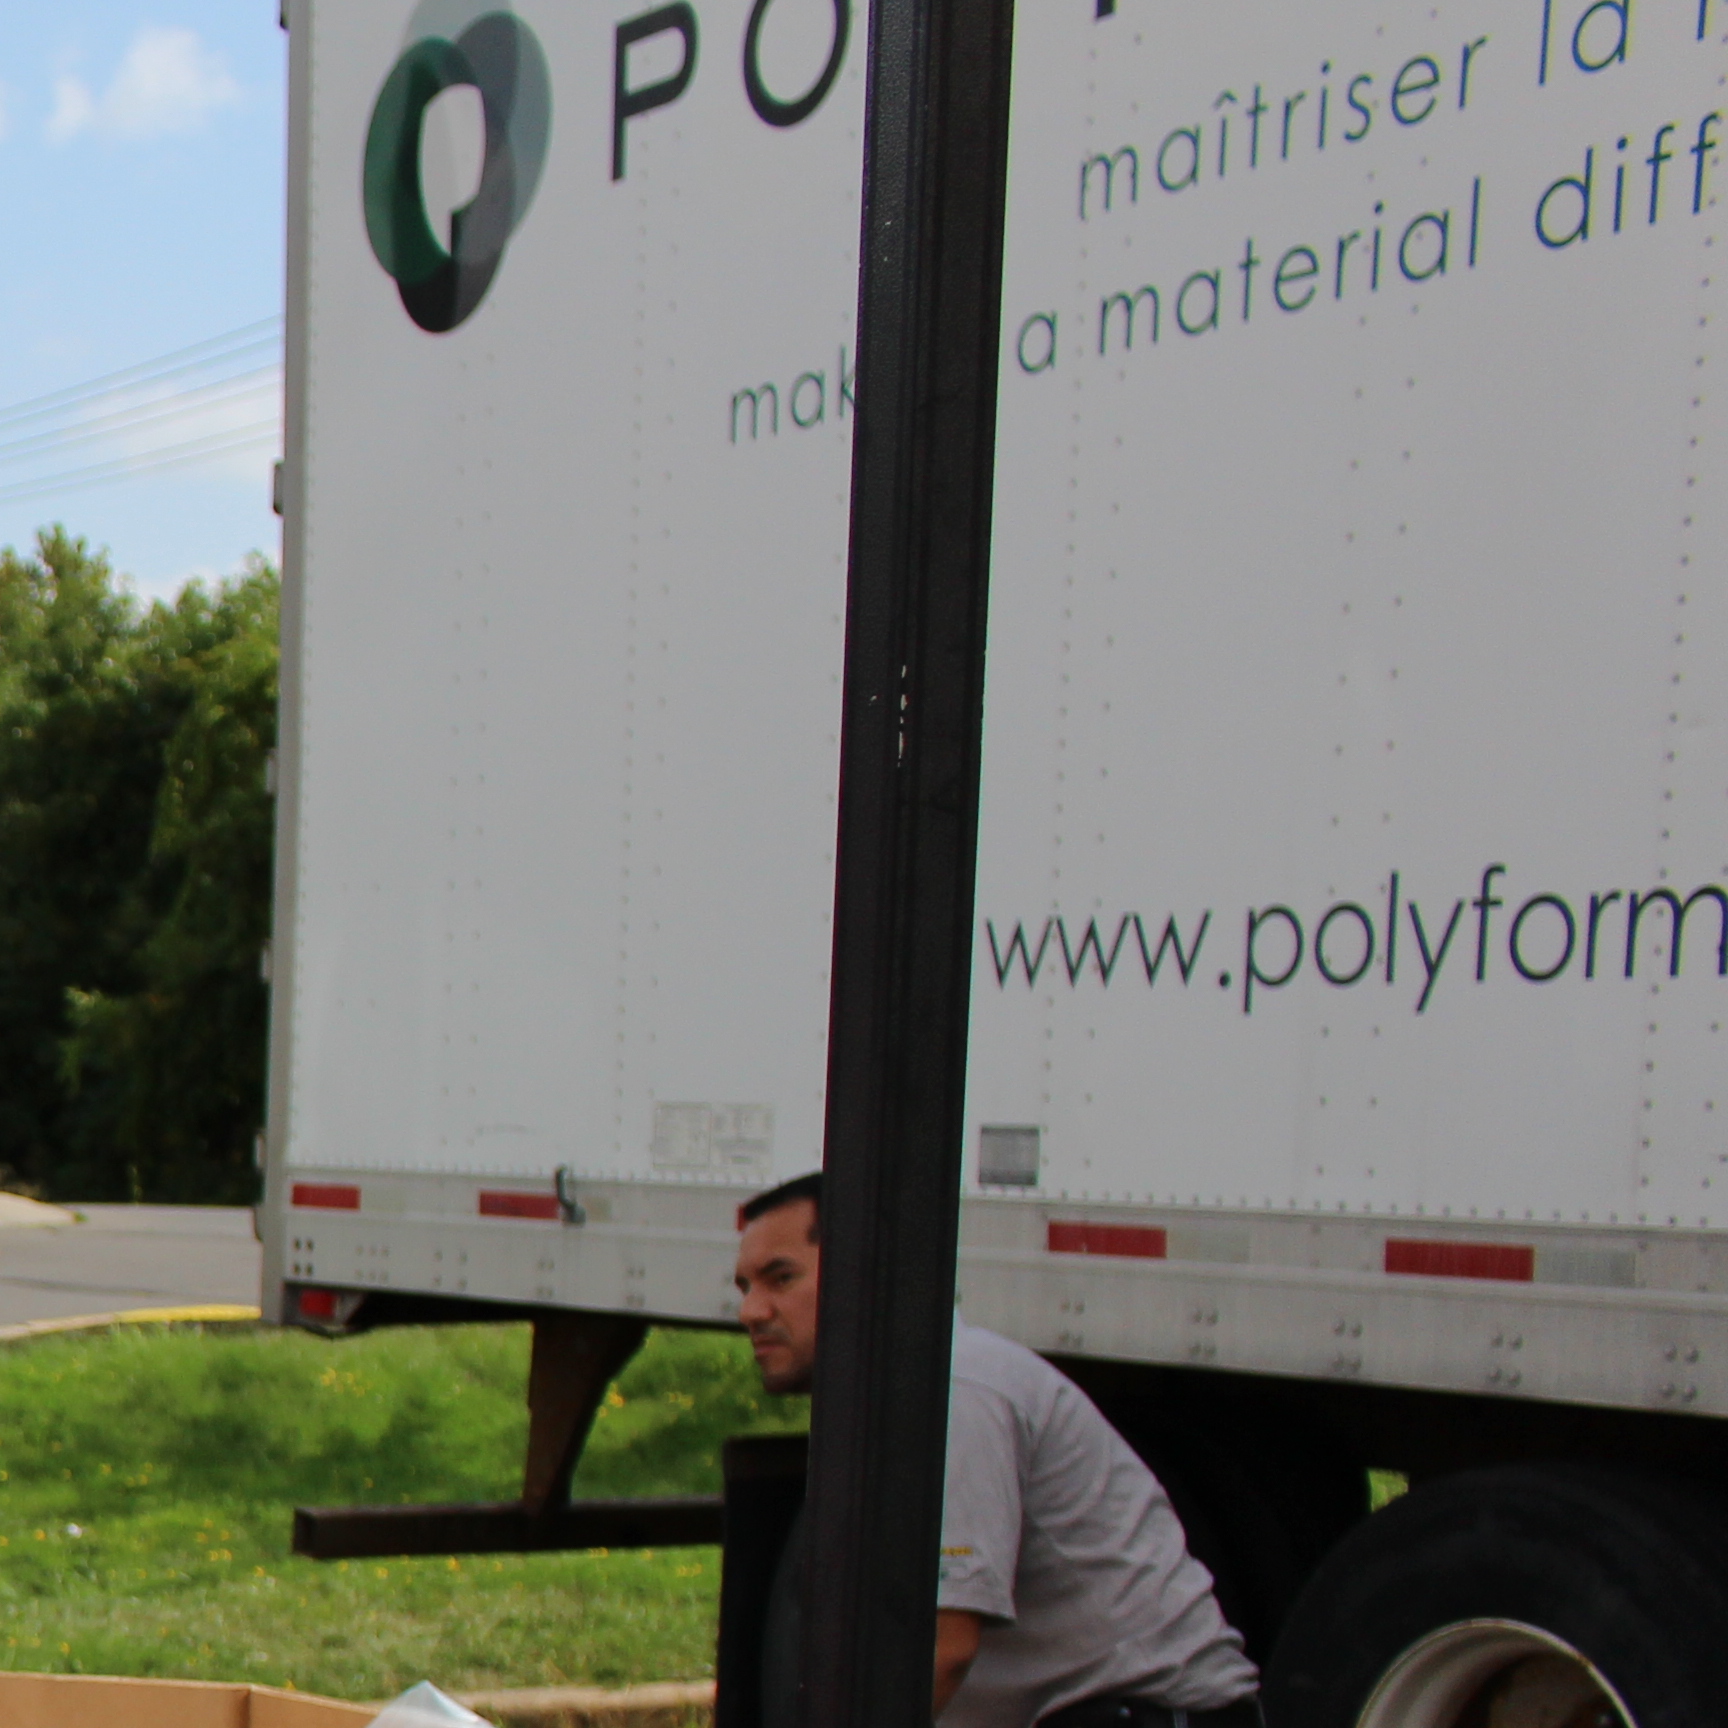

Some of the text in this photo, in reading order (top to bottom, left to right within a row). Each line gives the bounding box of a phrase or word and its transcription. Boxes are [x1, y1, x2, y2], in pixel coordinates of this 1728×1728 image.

[1079, 36, 1489, 221] maîtriser
[1017, 307, 1057, 374] a
[1099, 176, 1480, 356] material
[985, 864, 1728, 1014] www.polyform
